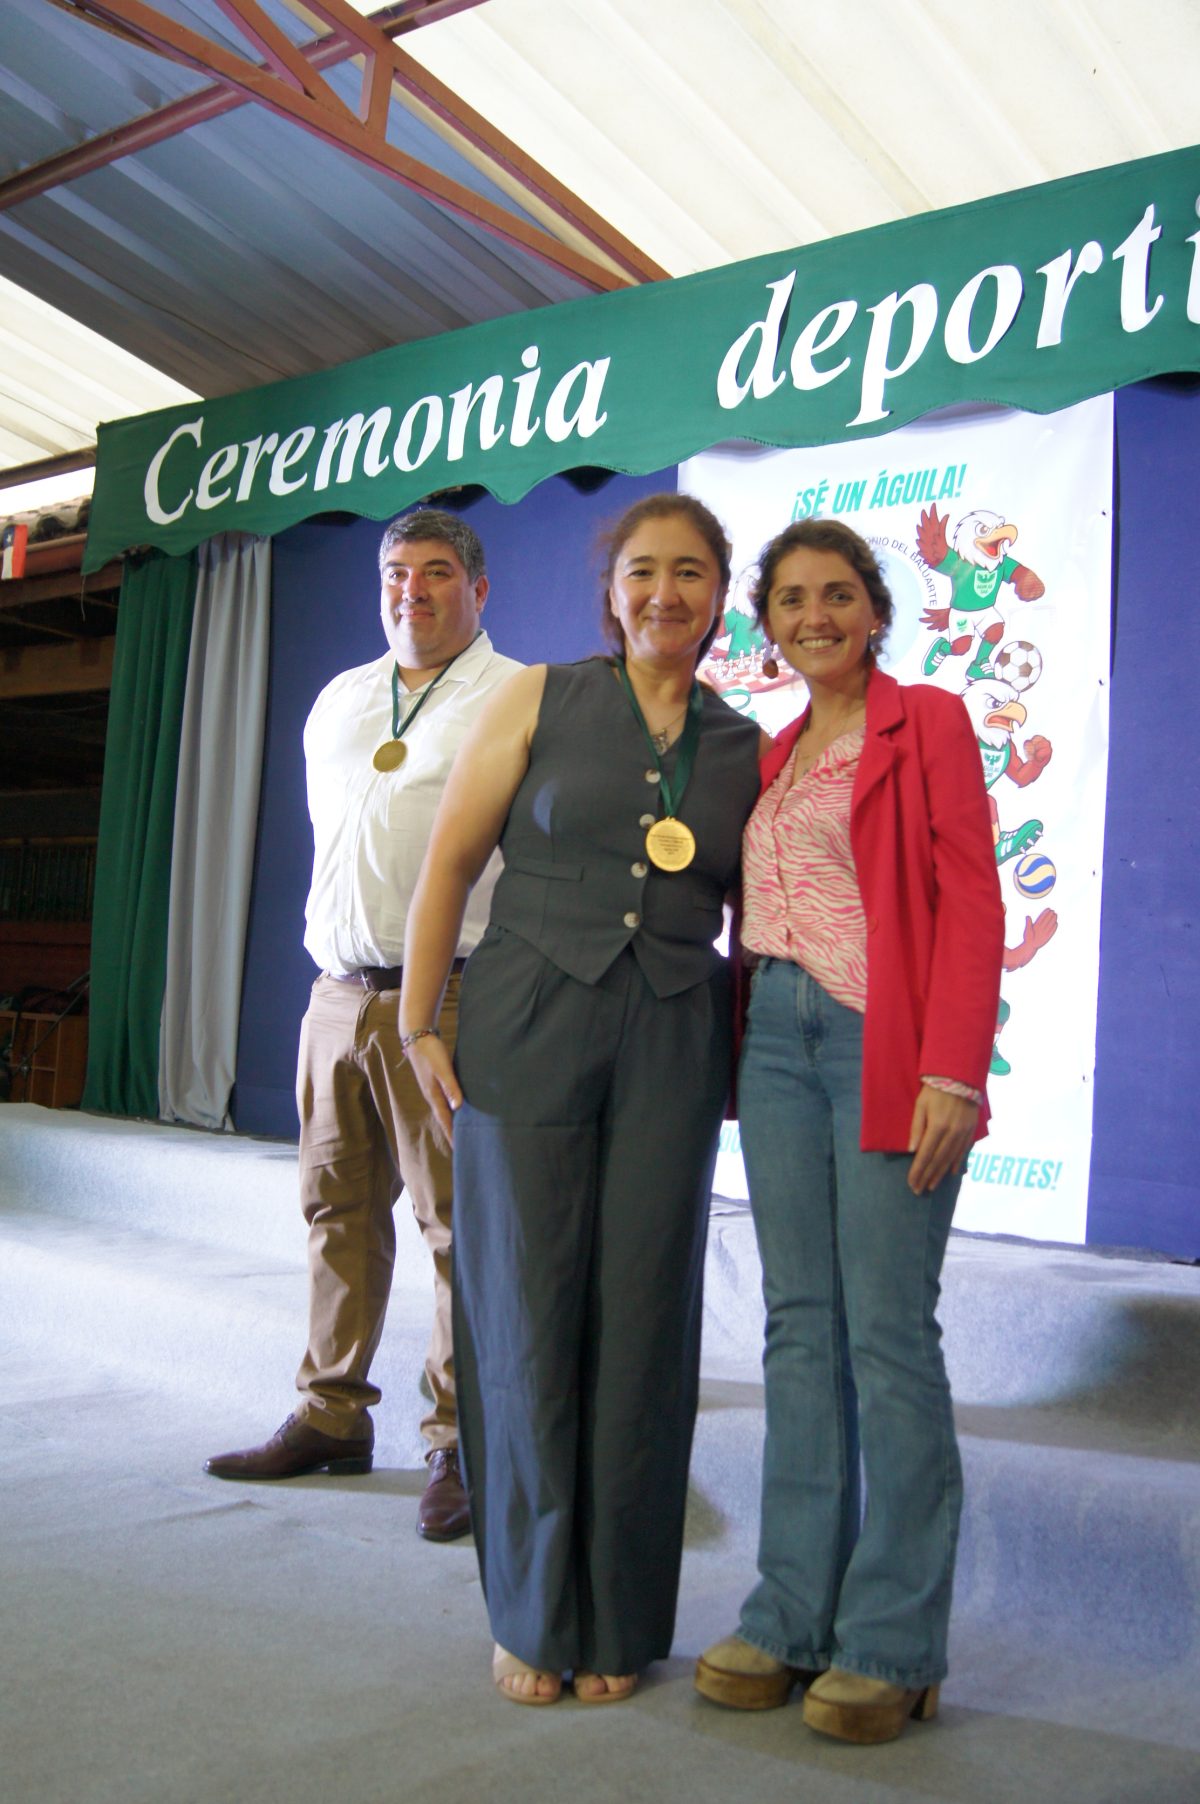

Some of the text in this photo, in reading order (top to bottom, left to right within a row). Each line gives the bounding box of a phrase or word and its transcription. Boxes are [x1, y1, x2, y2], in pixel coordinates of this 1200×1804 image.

[143, 345, 611, 525] Ceremonia
[791, 464, 967, 522] ¡SÉ UN ÁGUILA!
[891, 539, 909, 555] DEL
[909, 551, 938, 607] BALUARTE
